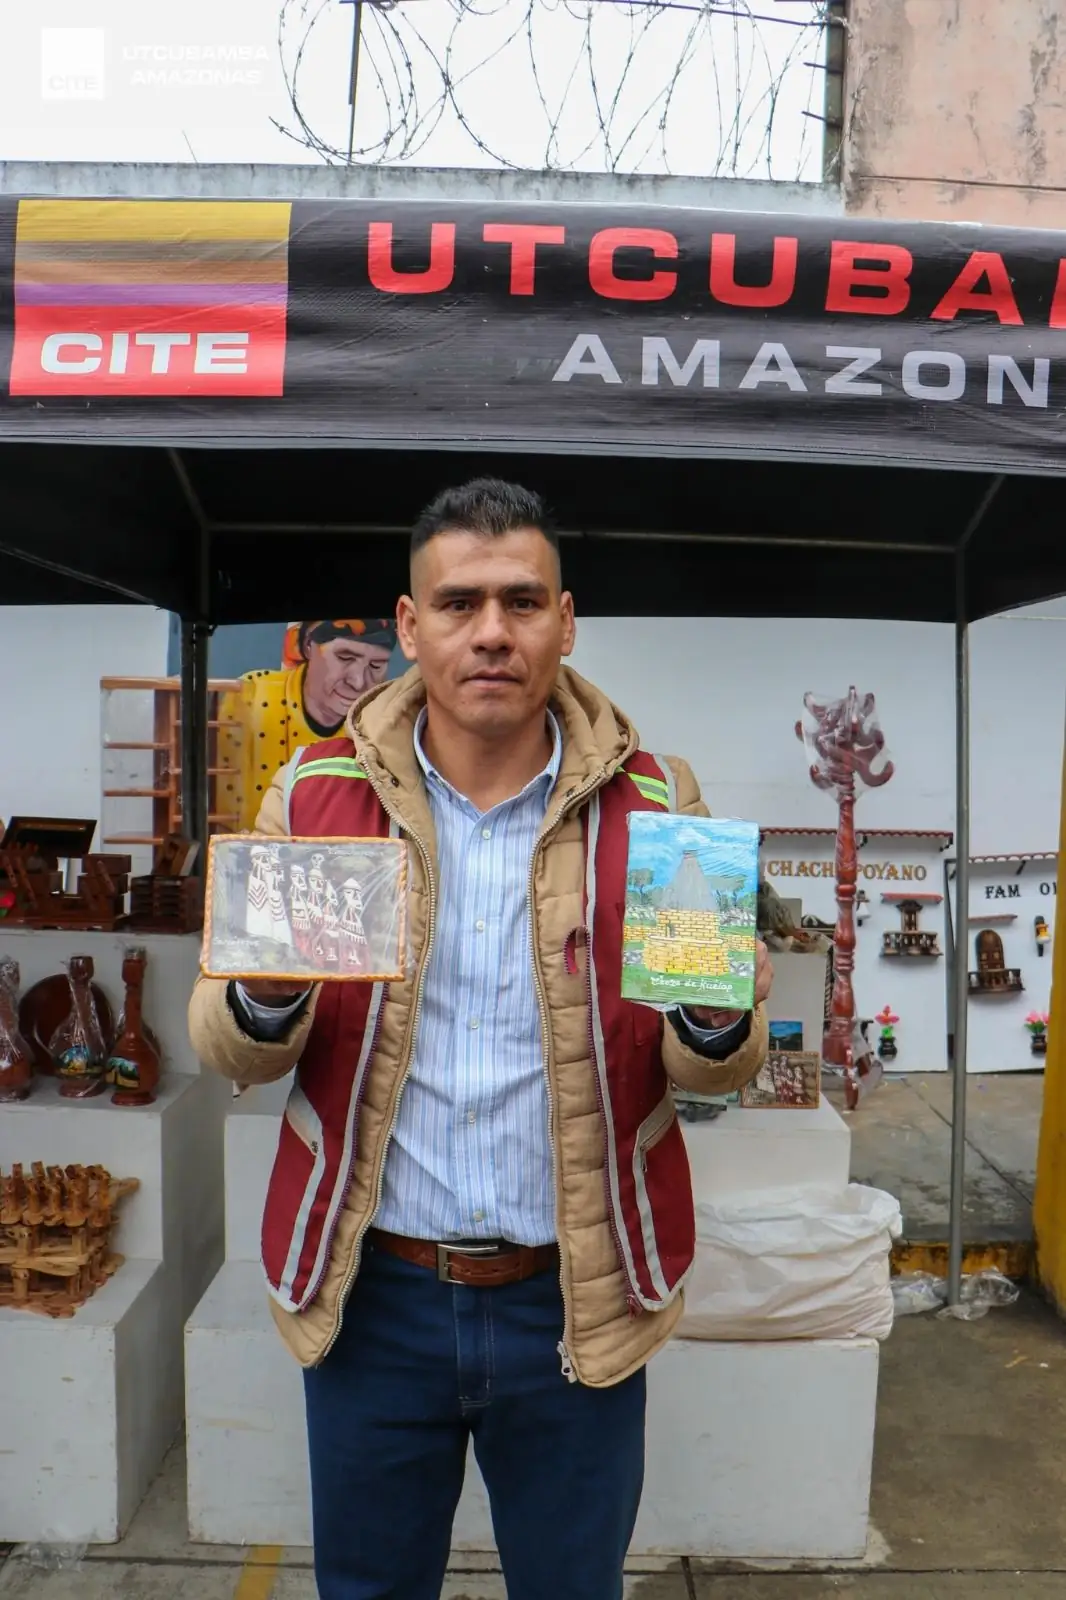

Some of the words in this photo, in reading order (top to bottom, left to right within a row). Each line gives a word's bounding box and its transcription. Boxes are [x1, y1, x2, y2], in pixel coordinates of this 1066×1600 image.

[367, 222, 1066, 329] UTCUBA
[40, 333, 249, 374] CITE
[552, 334, 1050, 408] AMAZON
[766, 860, 927, 881] CHACHOYANO
[985, 884, 1021, 899] FAM
